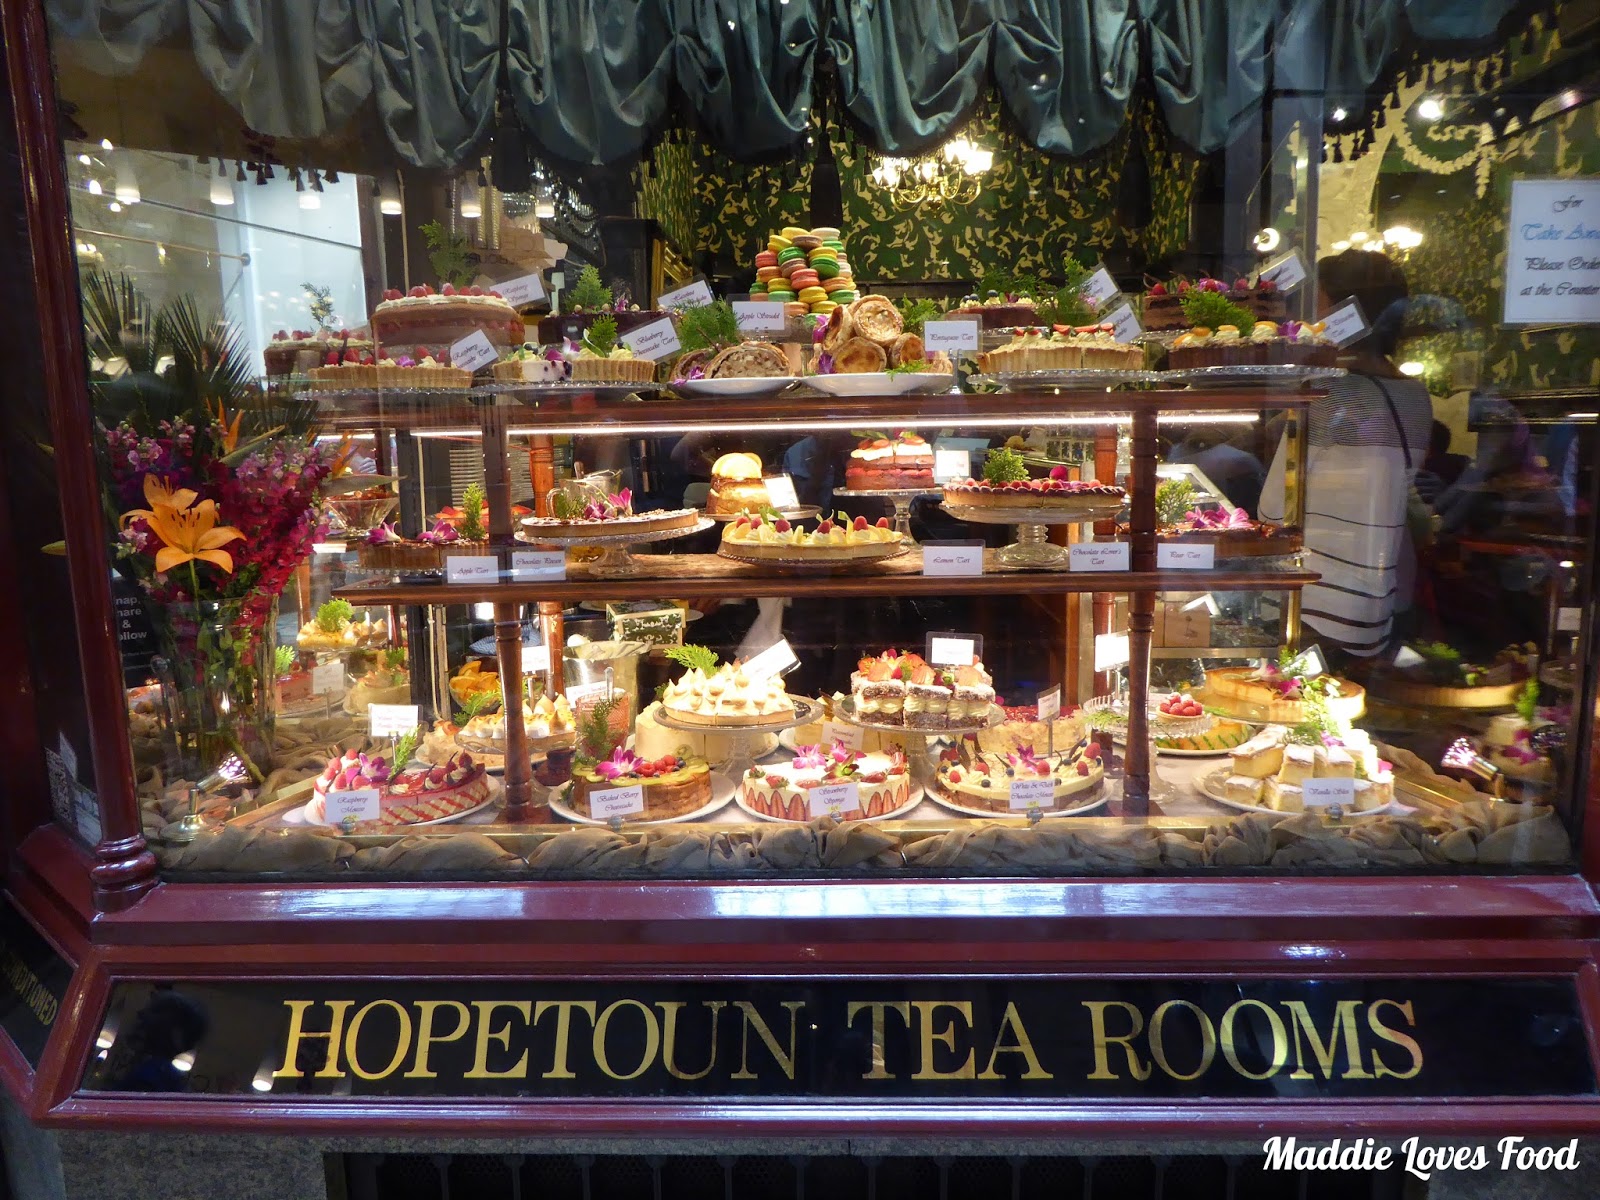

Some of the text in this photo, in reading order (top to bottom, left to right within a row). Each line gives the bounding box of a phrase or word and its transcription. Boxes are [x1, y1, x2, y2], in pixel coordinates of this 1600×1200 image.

[1551, 194, 1585, 213] For
[1520, 222, 1564, 241] Take
[1524, 255, 1600, 271] Please Orde
[1519, 285, 1534, 296] at
[1534, 282, 1553, 296] the
[960, 333, 975, 341] Tart
[476, 346, 491, 357] Tart
[955, 556, 971, 564] Tart
[1186, 551, 1201, 559] Tart
[1090, 557, 1105, 565] Tart
[475, 566, 489, 574] Tart
[122, 619, 132, 629] &
[272, 999, 1424, 1081] HOPETOUN TEA ROOMS
